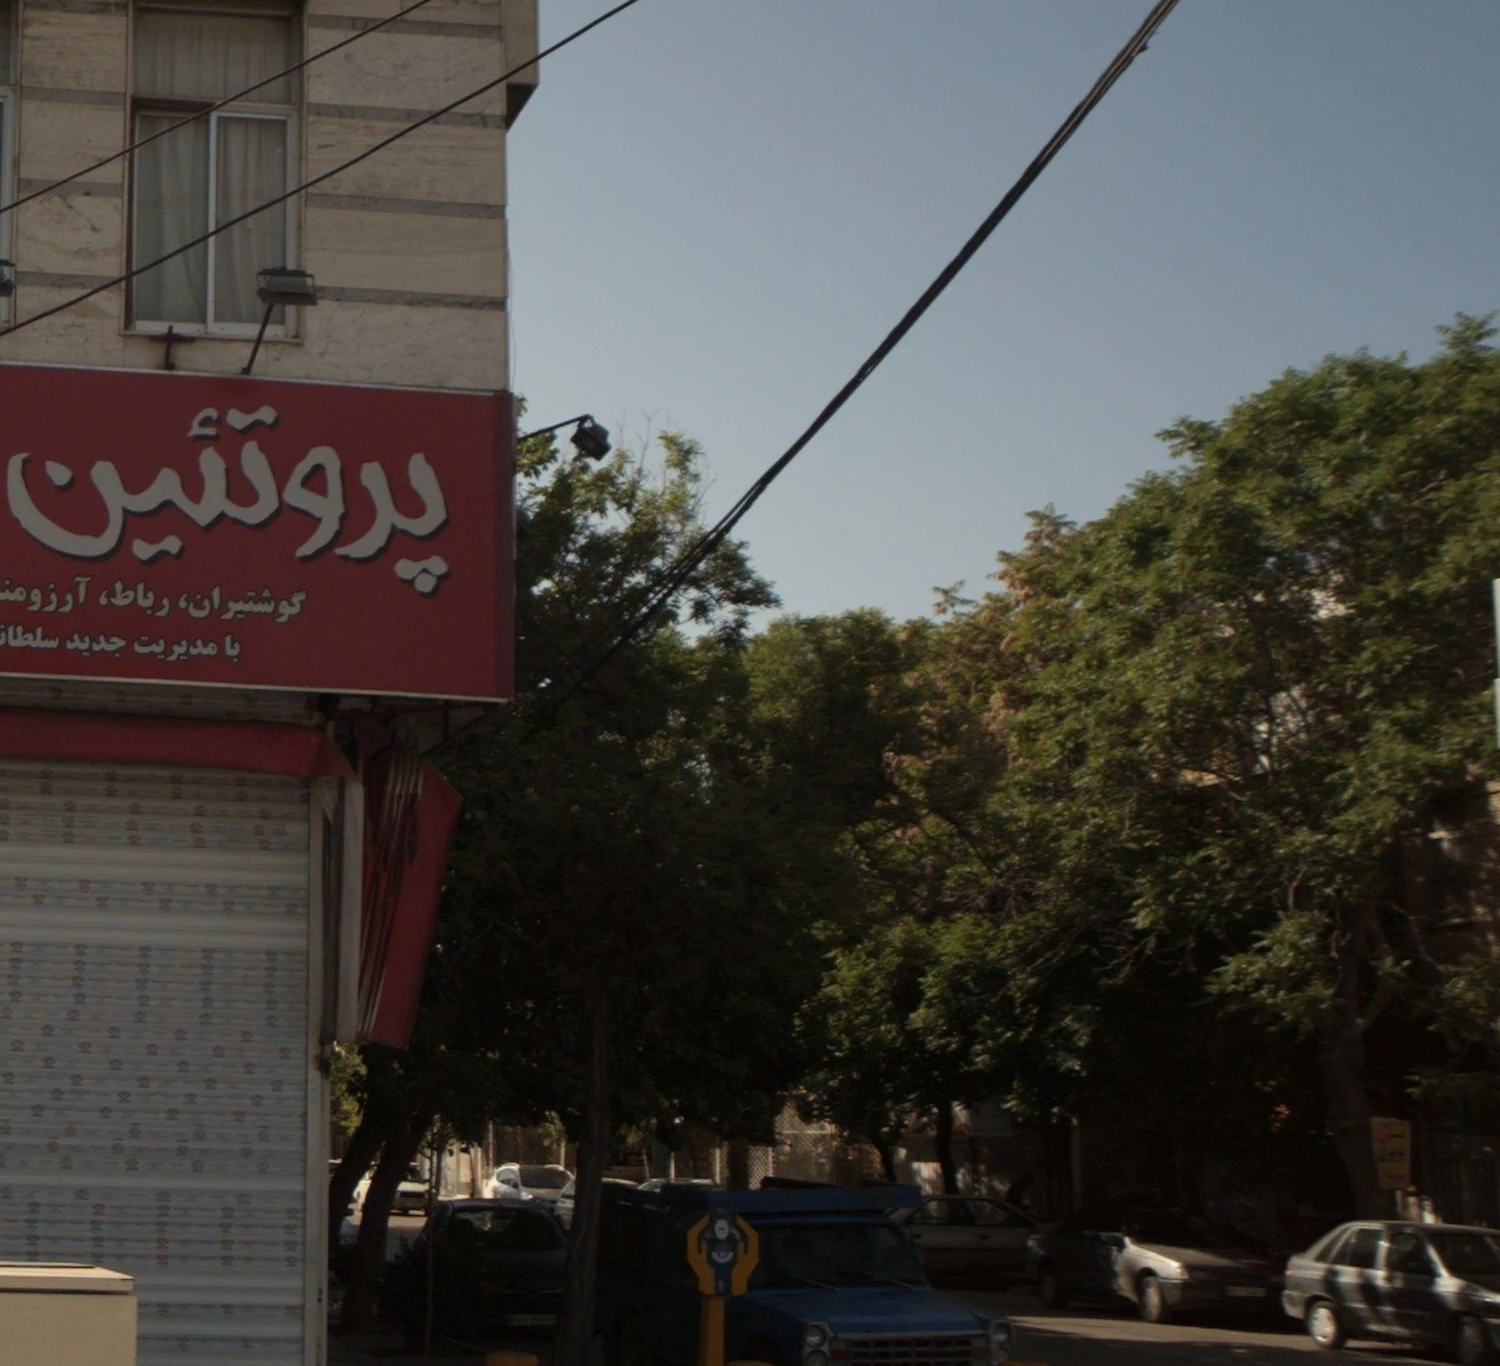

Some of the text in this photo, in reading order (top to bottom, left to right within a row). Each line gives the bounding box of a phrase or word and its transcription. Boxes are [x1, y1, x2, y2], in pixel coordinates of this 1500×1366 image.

[6, 406, 447, 595] پروتئین
[65, 632, 127, 658] جدید
[133, 633, 218, 663] مدیریت
[223, 635, 241, 663] با
